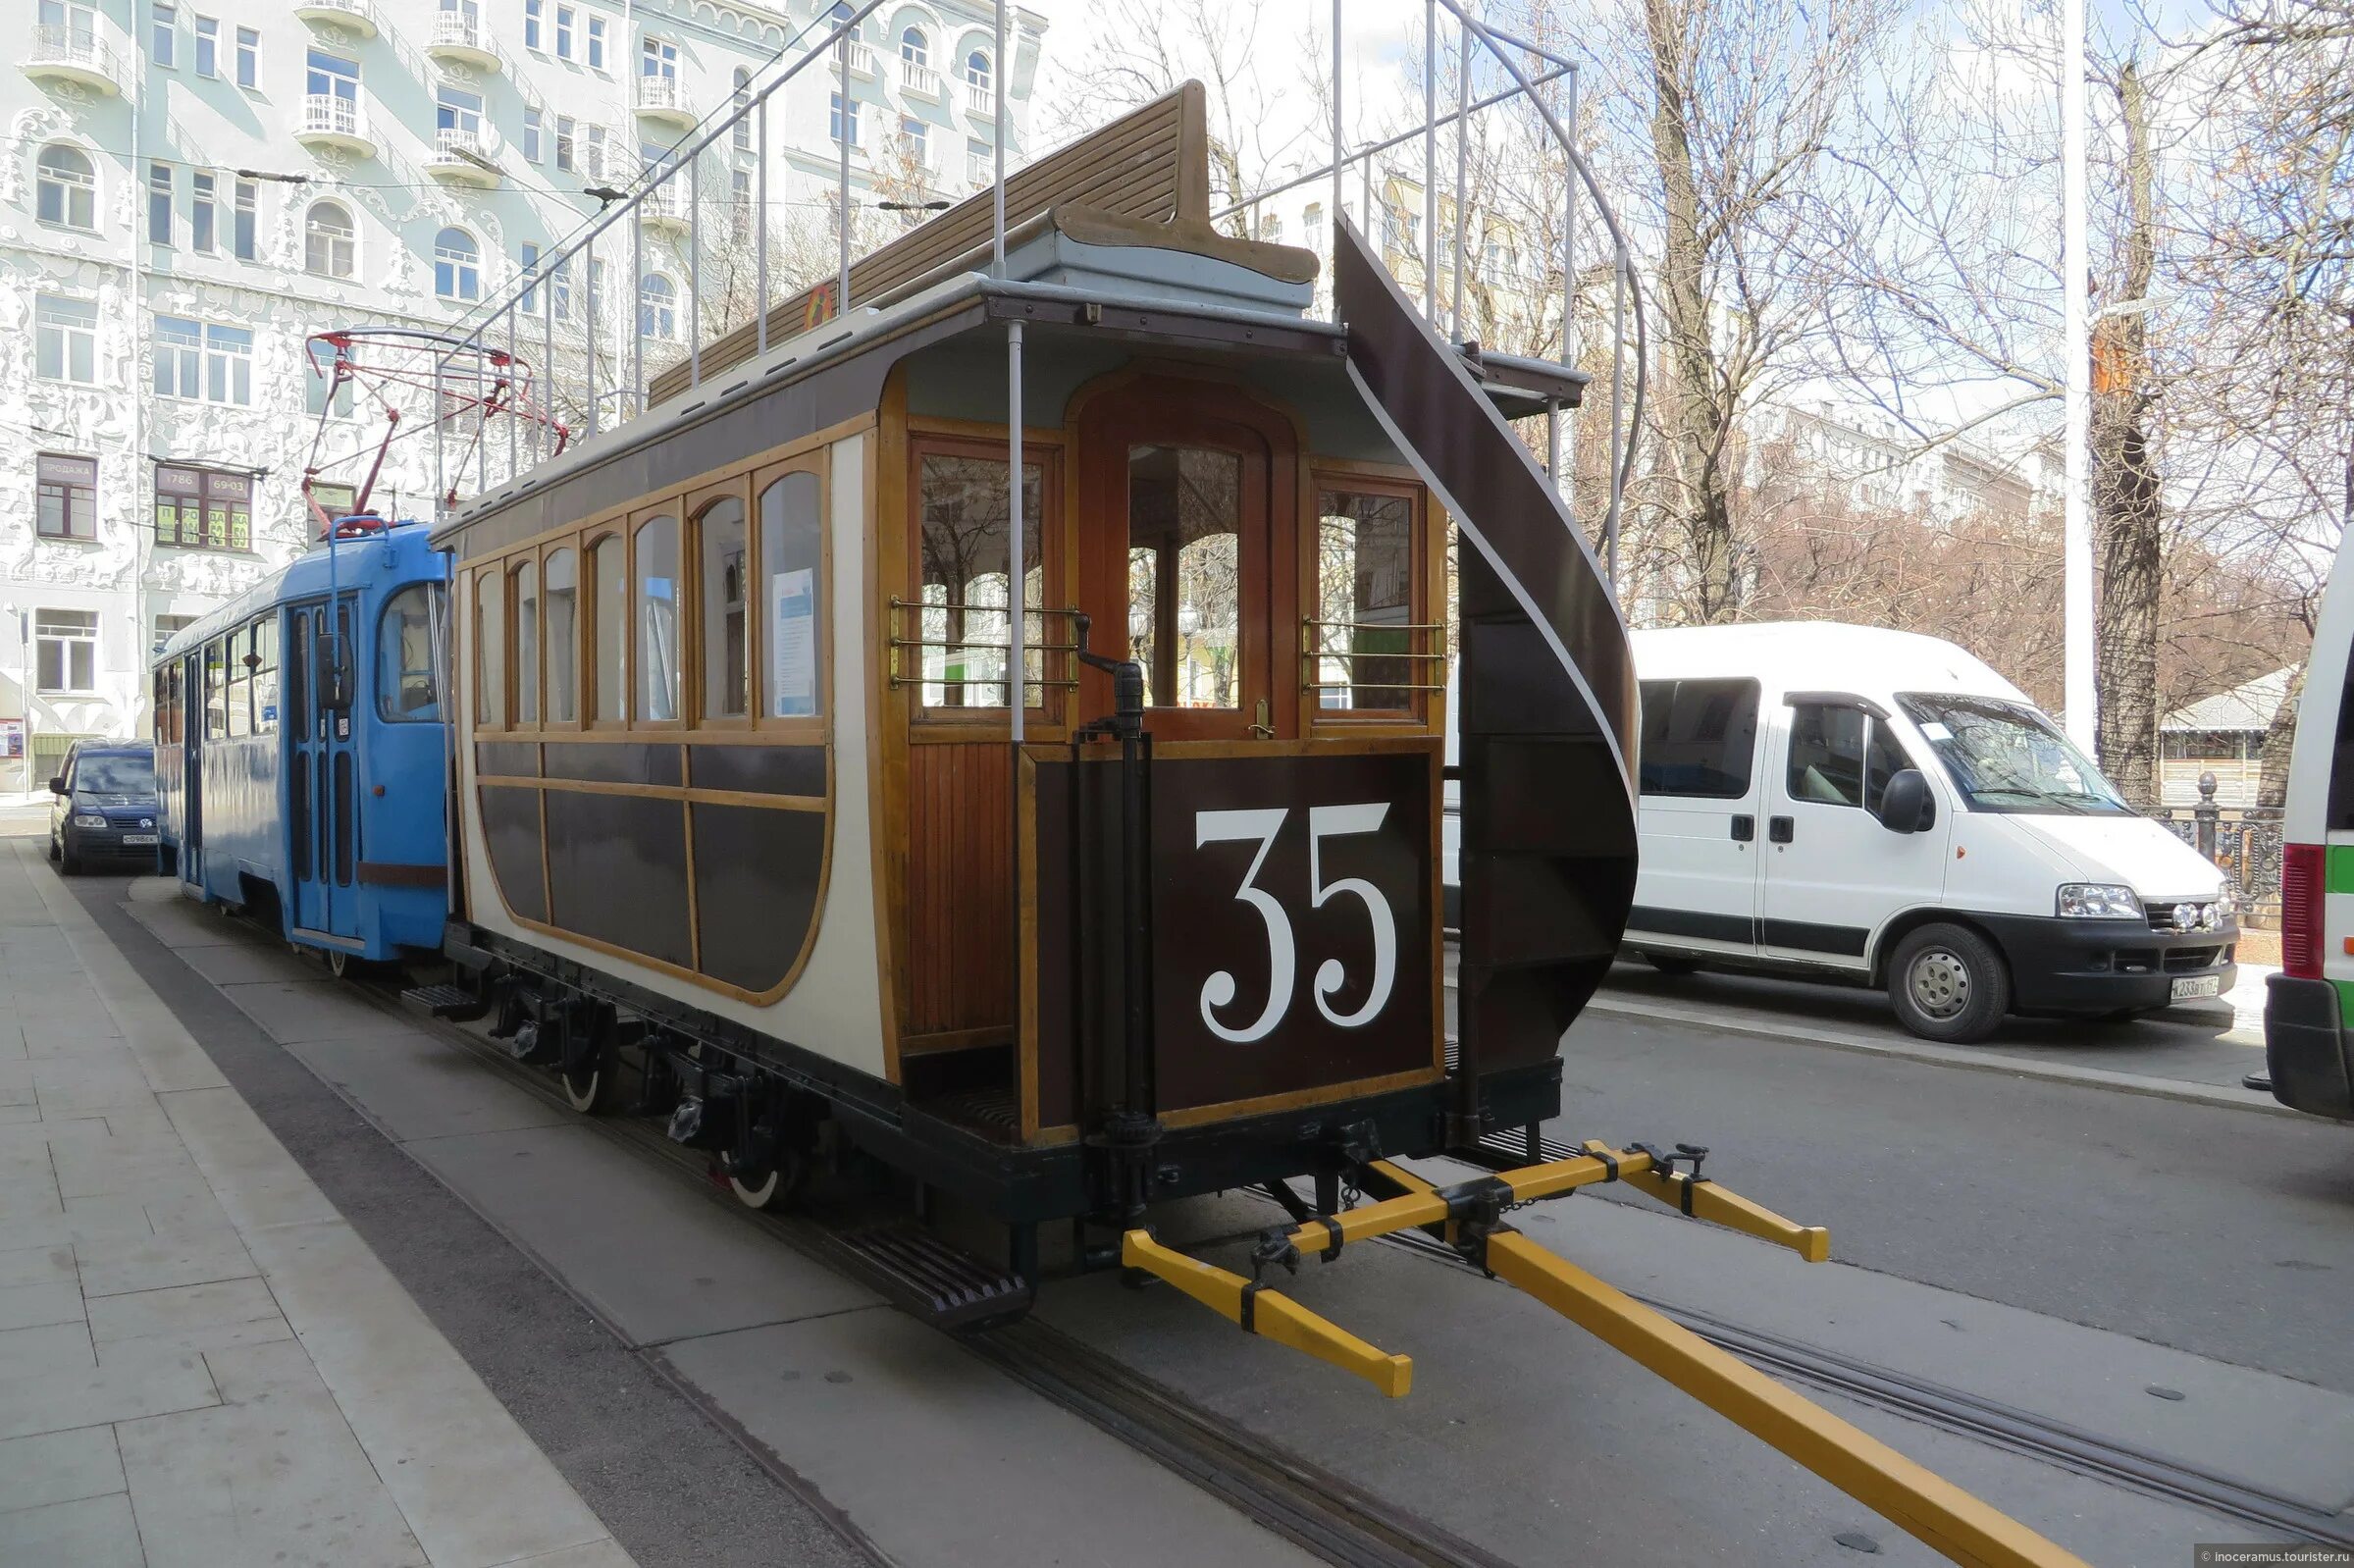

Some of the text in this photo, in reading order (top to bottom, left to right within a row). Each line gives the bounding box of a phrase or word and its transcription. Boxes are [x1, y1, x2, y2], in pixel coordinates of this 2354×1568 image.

[42, 463, 90, 476] ПРОДАЖА
[214, 480, 244, 492] 69-03
[1195, 802, 1397, 1043] 35
